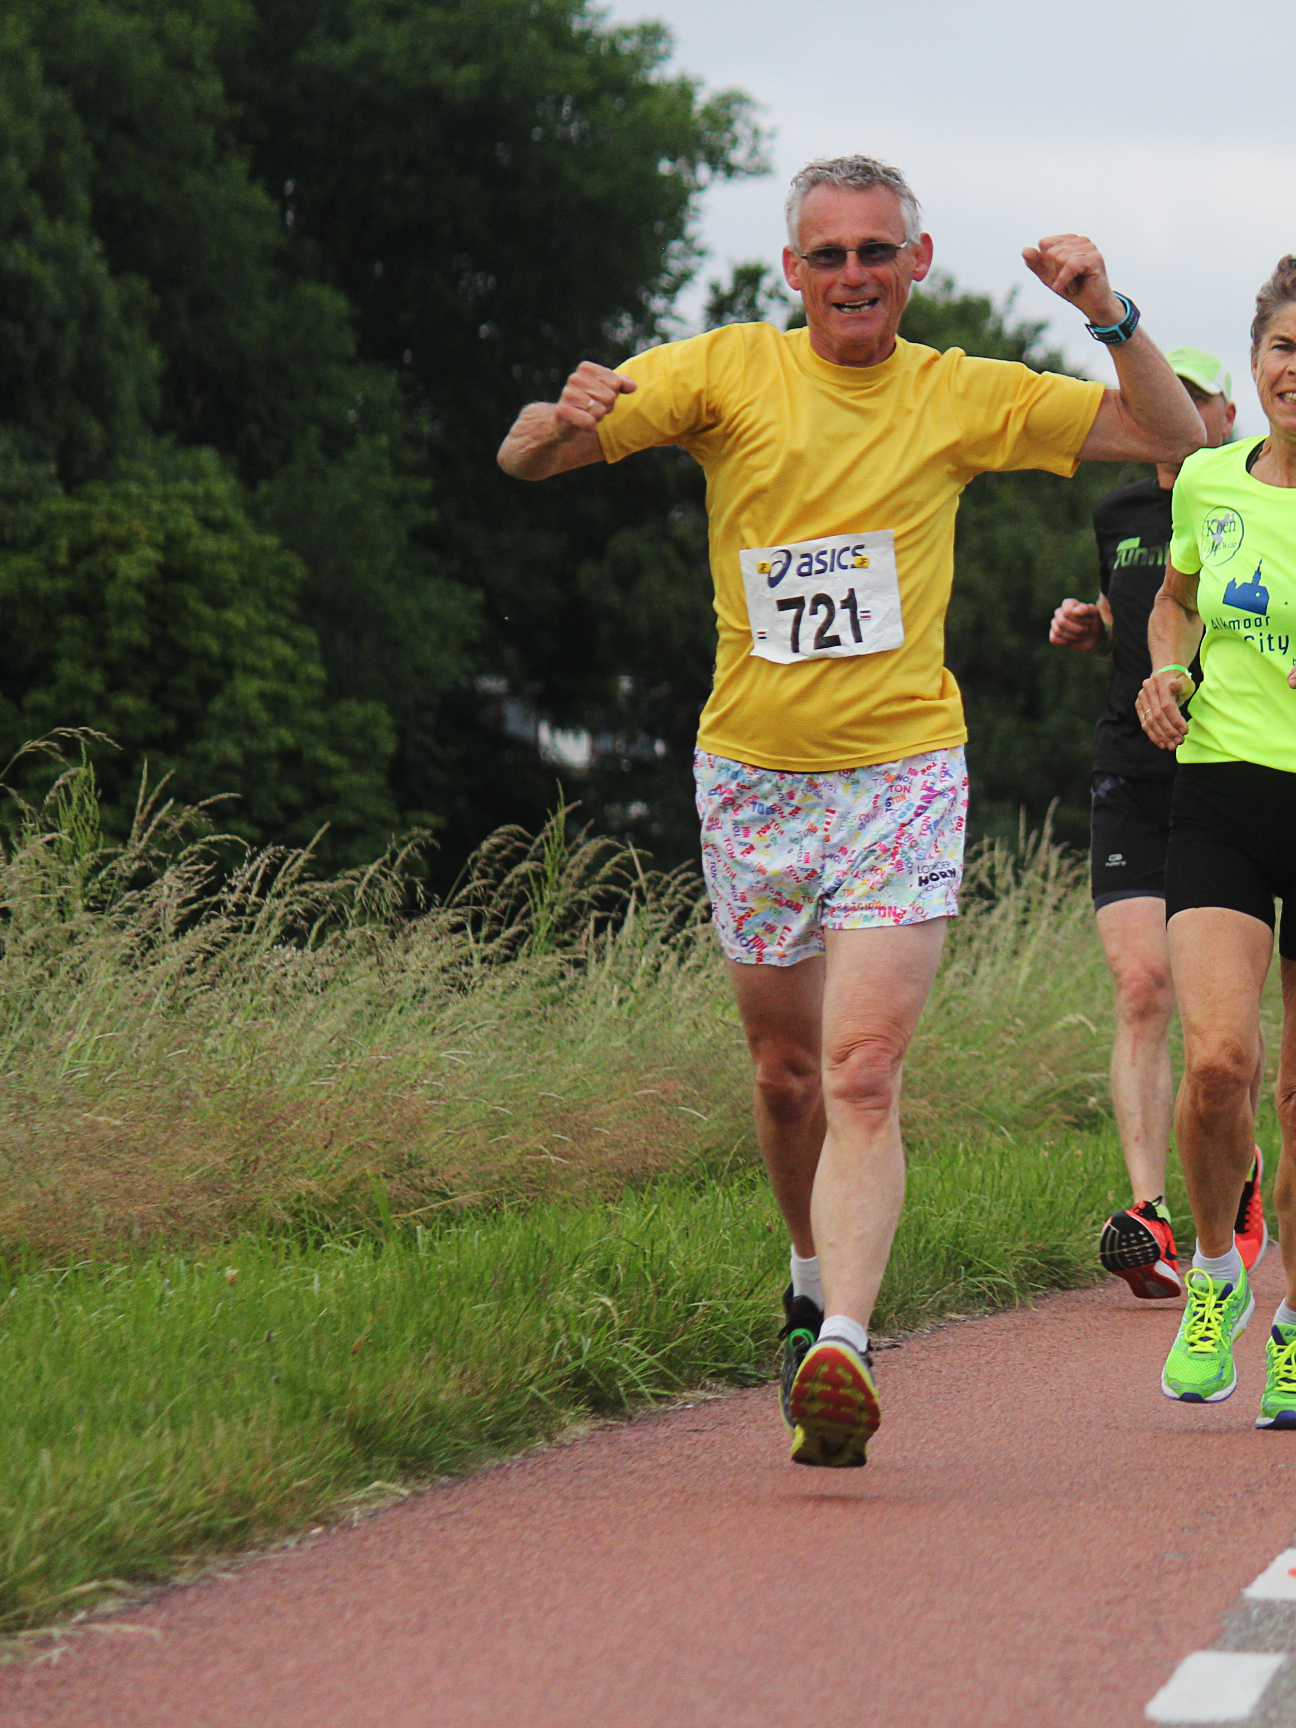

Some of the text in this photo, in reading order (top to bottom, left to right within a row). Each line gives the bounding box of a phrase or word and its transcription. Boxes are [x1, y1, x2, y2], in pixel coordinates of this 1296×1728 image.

[1205, 520, 1236, 537] Koen
[796, 544, 865, 577] asics
[775, 587, 864, 654] 721
[1210, 615, 1270, 631] Alkmaar
[888, 784, 911, 794] TON
